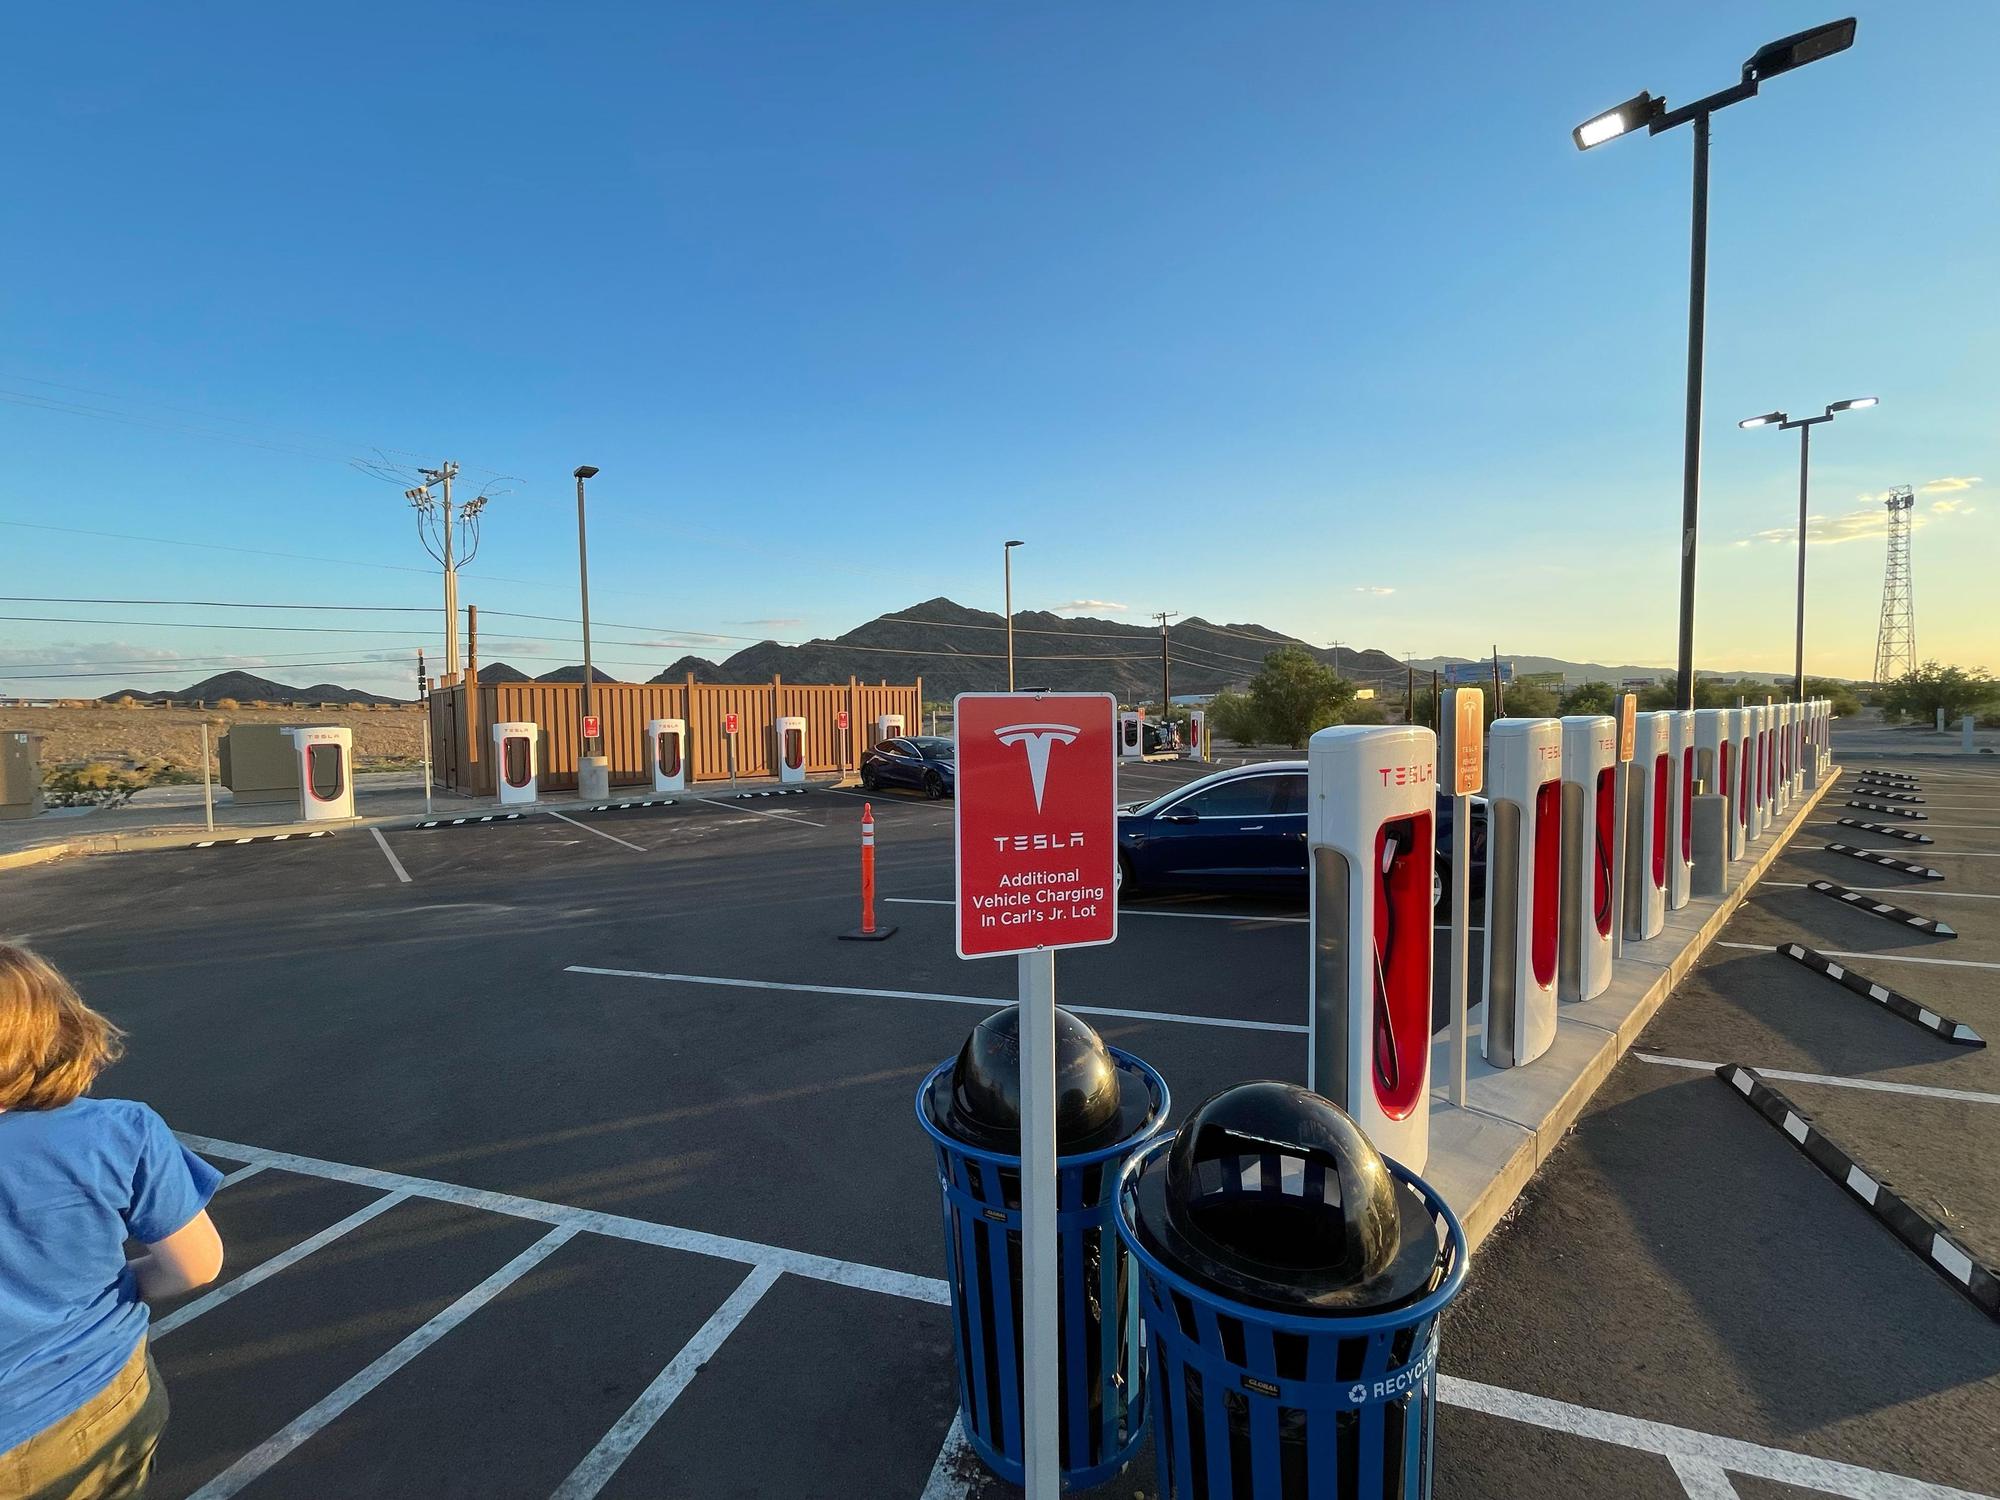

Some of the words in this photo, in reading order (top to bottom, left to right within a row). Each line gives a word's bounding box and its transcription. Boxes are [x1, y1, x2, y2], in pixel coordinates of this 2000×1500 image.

[1538, 745, 1561, 761] TES
[1378, 763, 1433, 787] TESLA
[993, 832, 1084, 852] TESLA
[999, 868, 1079, 888] Additional
[972, 891, 1031, 909] Vehicle
[1035, 886, 1104, 904] Charging
[981, 914, 995, 928] In
[1001, 908, 1044, 925] Carl's
[1048, 907, 1067, 921] Jr.
[1071, 904, 1097, 919] Lot
[1373, 1352, 1433, 1399] RECYCLE
